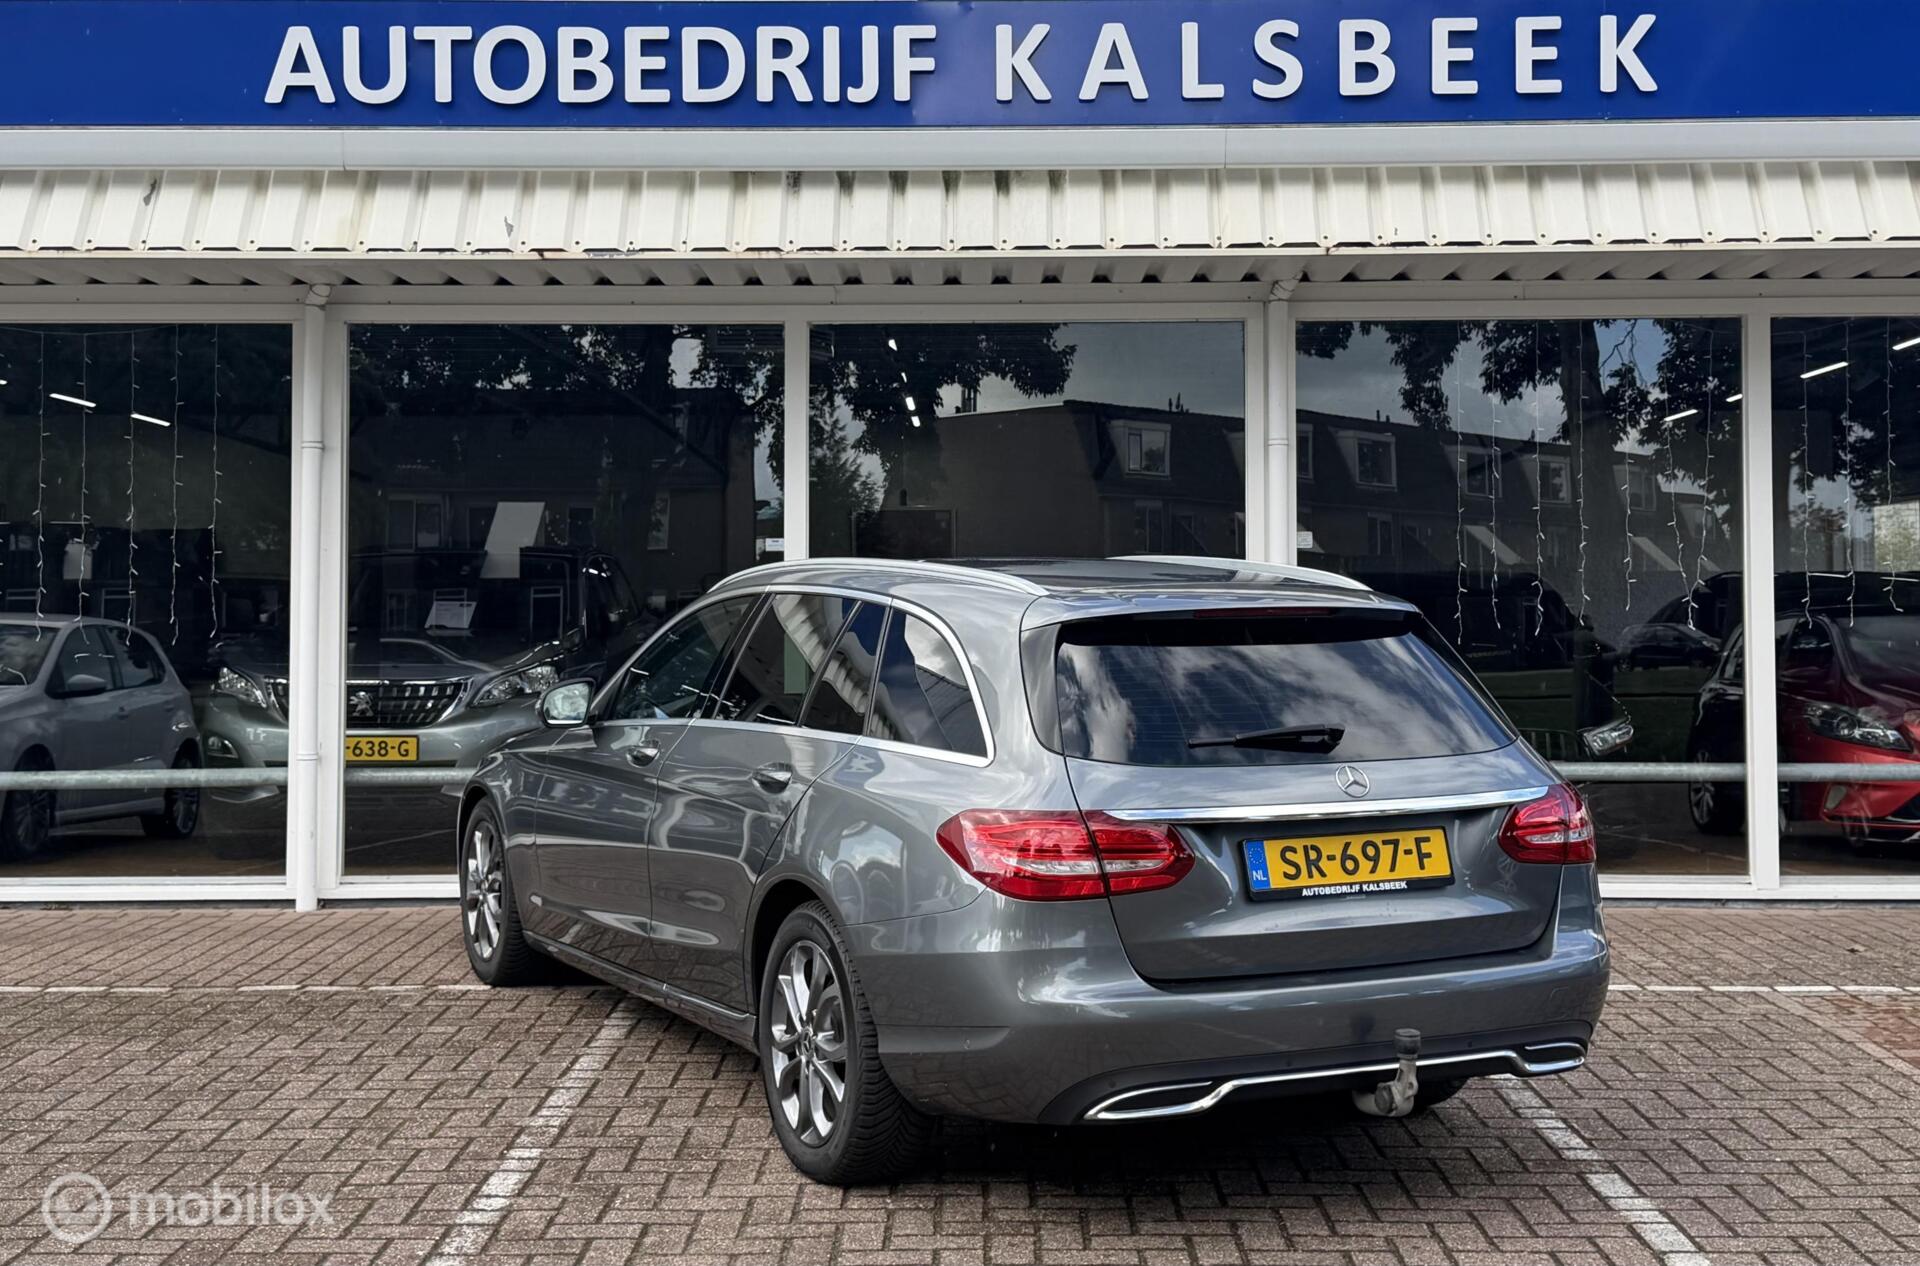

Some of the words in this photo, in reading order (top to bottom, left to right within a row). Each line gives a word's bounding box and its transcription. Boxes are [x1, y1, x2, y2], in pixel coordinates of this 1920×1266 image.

[264, 25, 937, 104] AUTOBEDRIJF
[995, 14, 1658, 101] KALSBEEK
[1280, 836, 1433, 881] SR-697-F
[1252, 870, 1267, 881] NL
[1301, 884, 1361, 896] AUTOBEDRIJF
[1362, 880, 1408, 893] KALSBEEK
